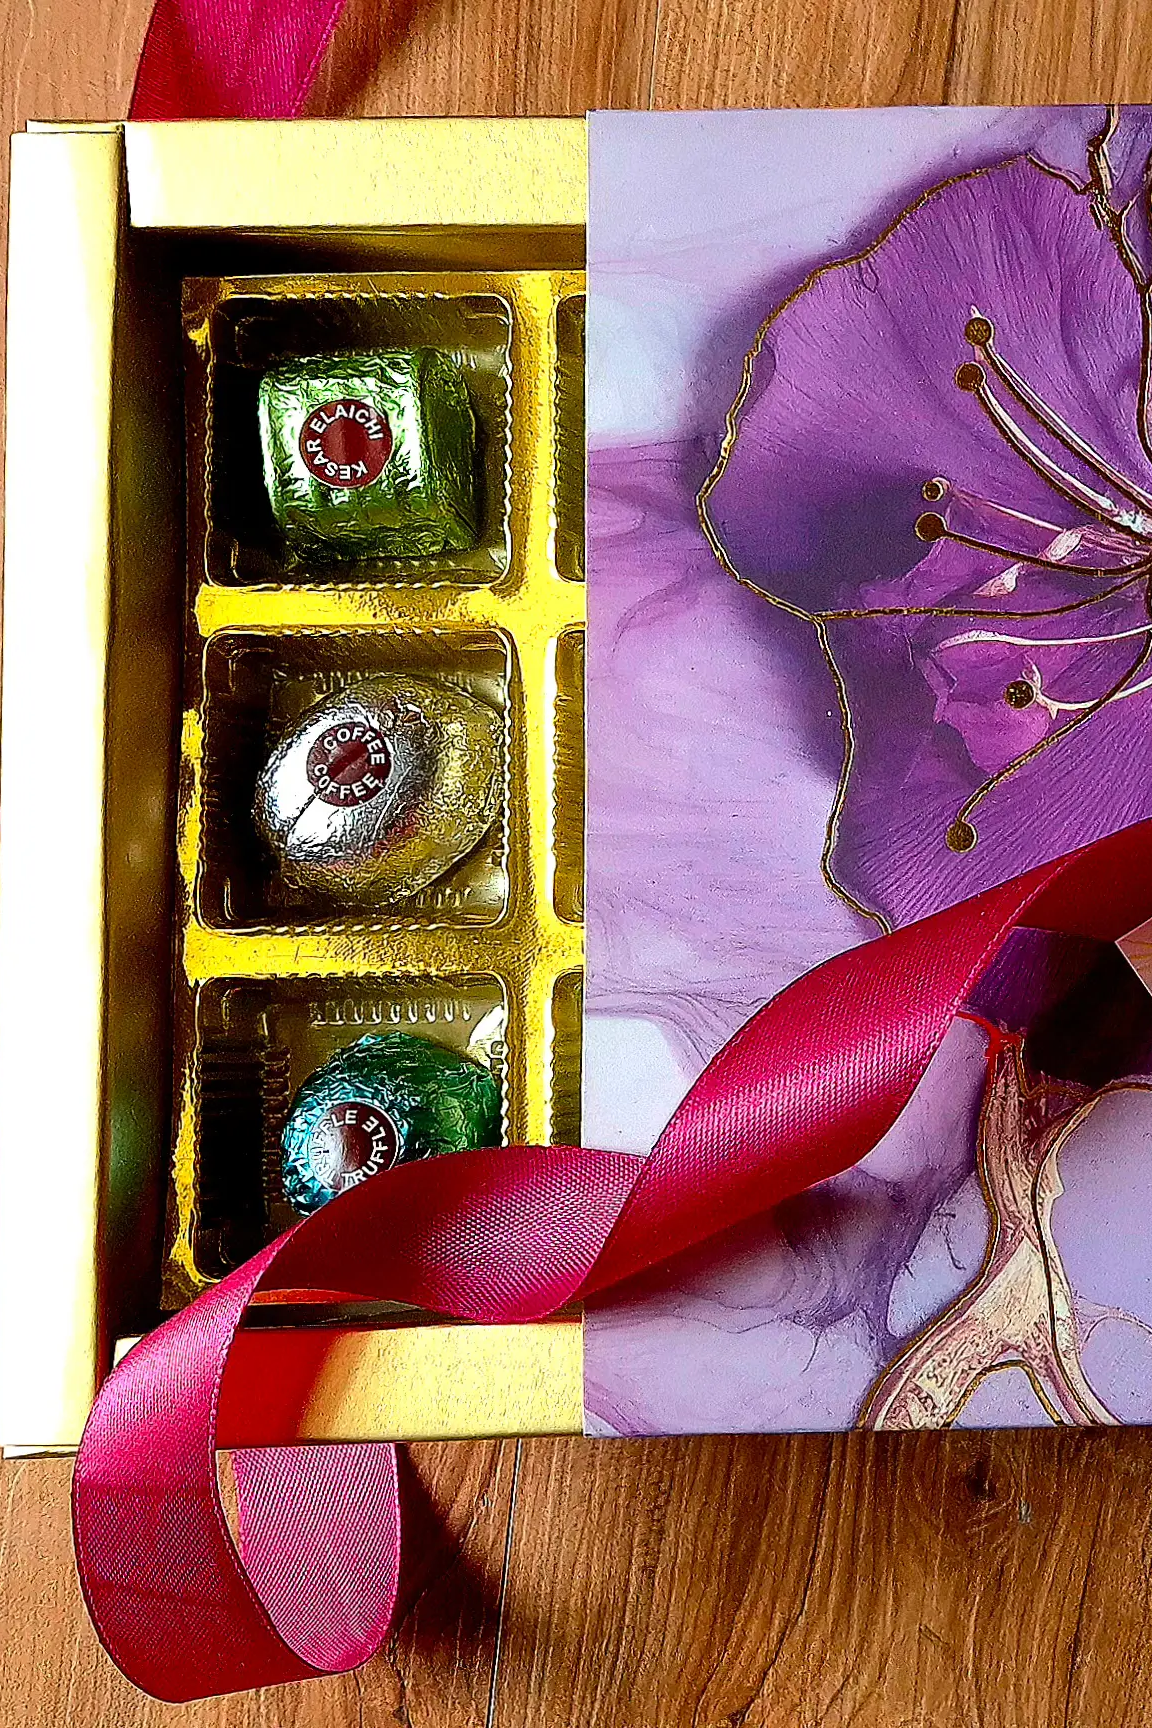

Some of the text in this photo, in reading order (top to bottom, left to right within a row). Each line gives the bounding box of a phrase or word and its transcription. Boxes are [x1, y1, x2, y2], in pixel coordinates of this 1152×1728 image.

[306, 404, 384, 480] KESAR ELAICHI
[323, 726, 385, 765] COFFEE
[314, 763, 378, 800] COFFEE
[340, 1115, 389, 1186] TRUFFLE
